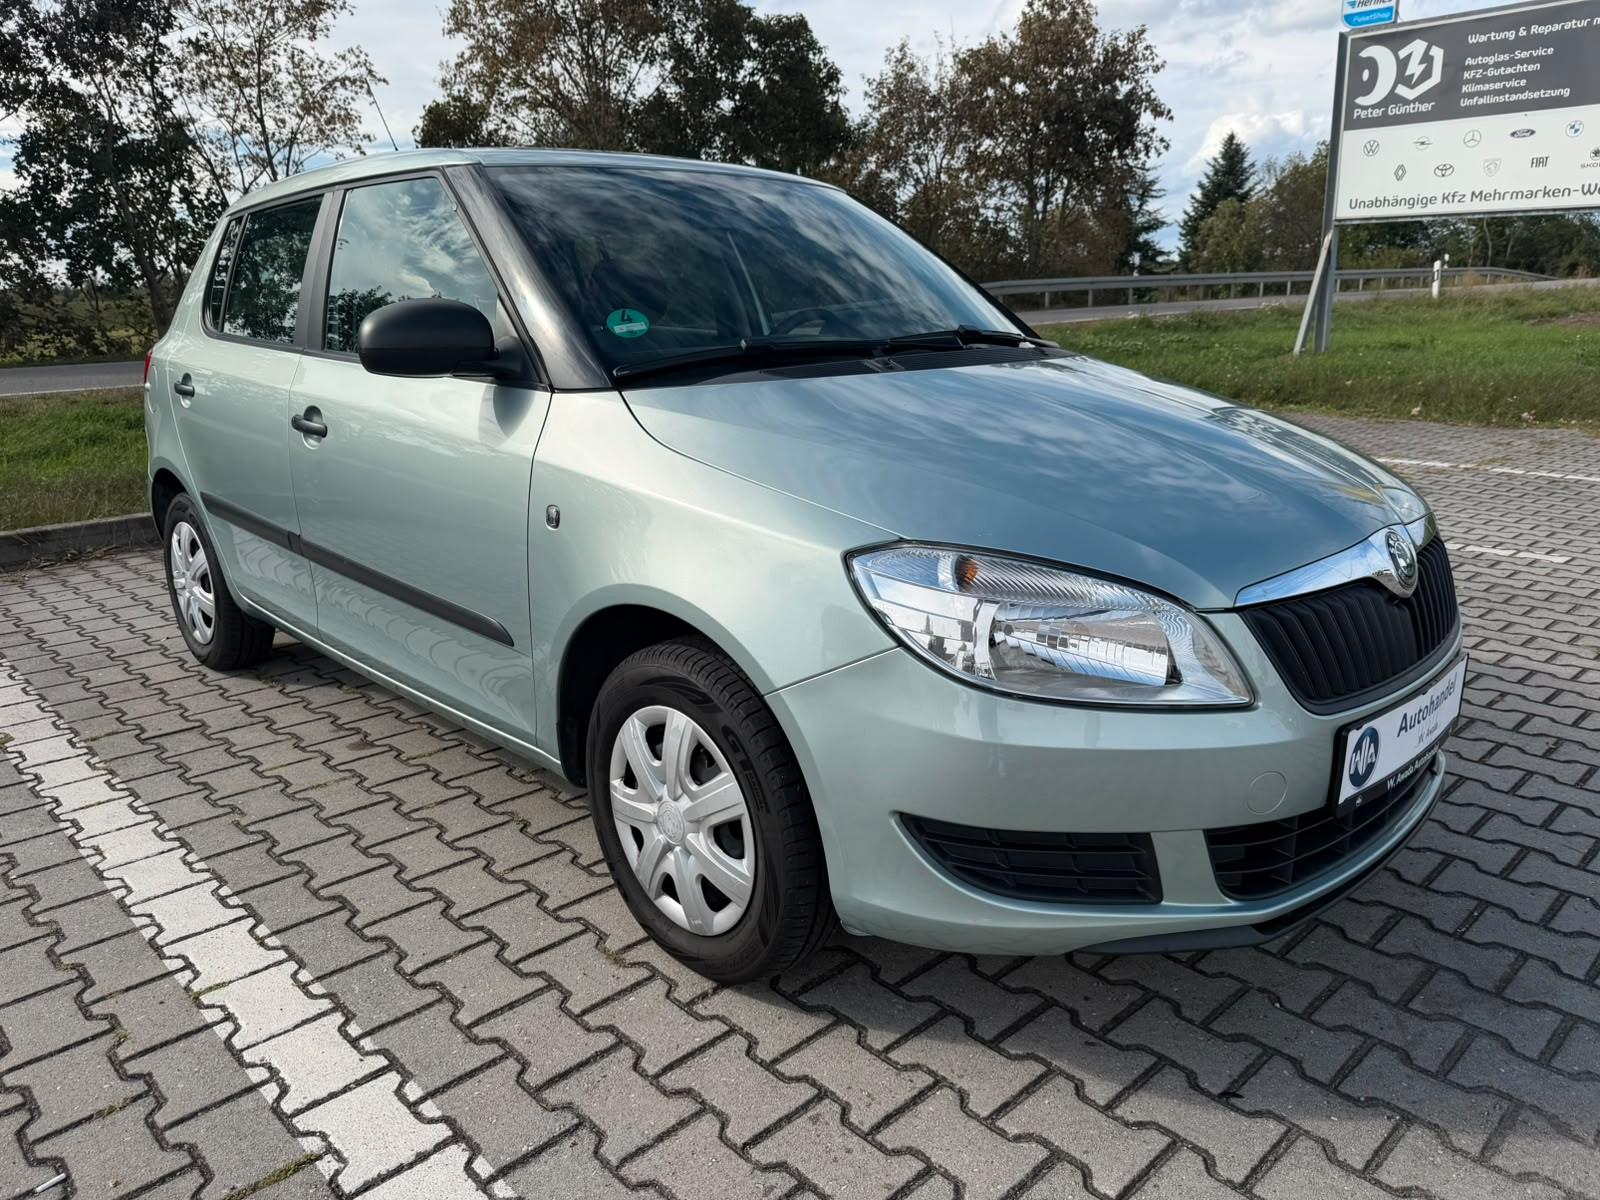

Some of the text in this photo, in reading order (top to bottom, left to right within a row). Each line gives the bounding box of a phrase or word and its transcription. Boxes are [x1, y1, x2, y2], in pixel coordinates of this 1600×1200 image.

[1468, 30, 1516, 44] Wartung
[1518, 26, 1527, 37] &
[1530, 17, 1591, 35] Reparatur
[1465, 46, 1555, 66] Autoglas-Service
[1463, 62, 1541, 80] KFZ-Gutachten
[1461, 78, 1527, 94] Klimaservice
[1460, 87, 1571, 107] Unfallinstandsetzung
[1353, 101, 1436, 120] Peter Günther
[1530, 155, 1550, 169] FIAT
[1349, 192, 1438, 210] Unabhängige
[1441, 190, 1466, 205] Kfz
[1397, 671, 1458, 738] Autohandel
